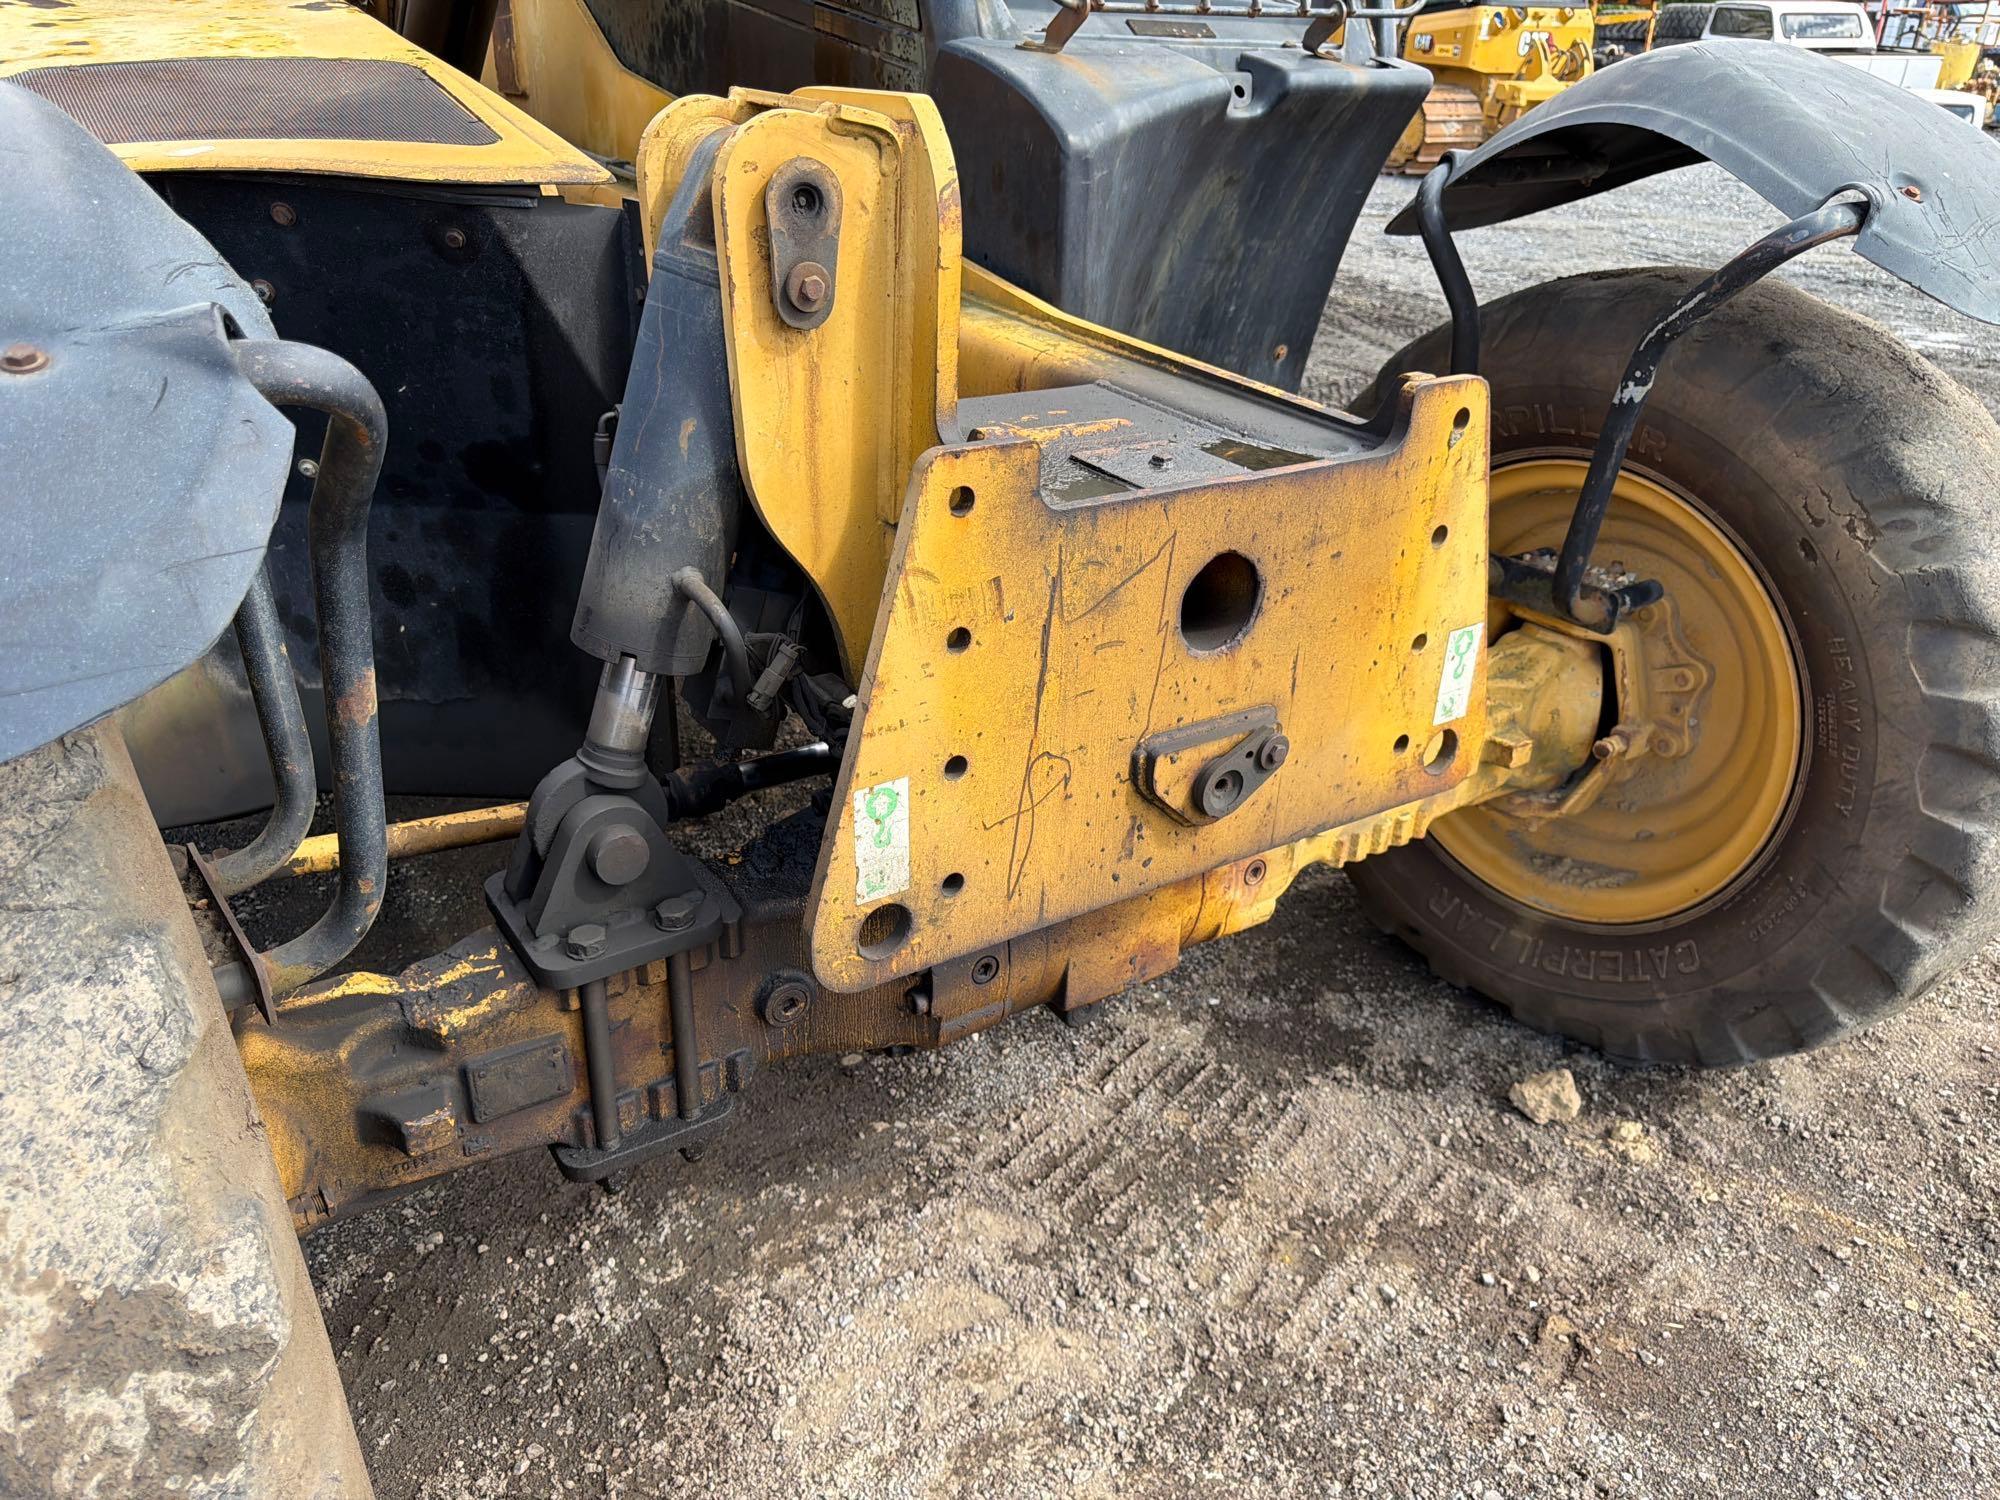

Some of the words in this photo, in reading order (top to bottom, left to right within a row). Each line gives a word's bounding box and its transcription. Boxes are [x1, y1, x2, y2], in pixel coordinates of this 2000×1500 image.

[1517, 31, 1550, 56] CT
[1827, 636, 1861, 732] HEAVY
[1836, 746, 1861, 817] DUTY
[1428, 886, 1701, 981] CATERPILLAR
